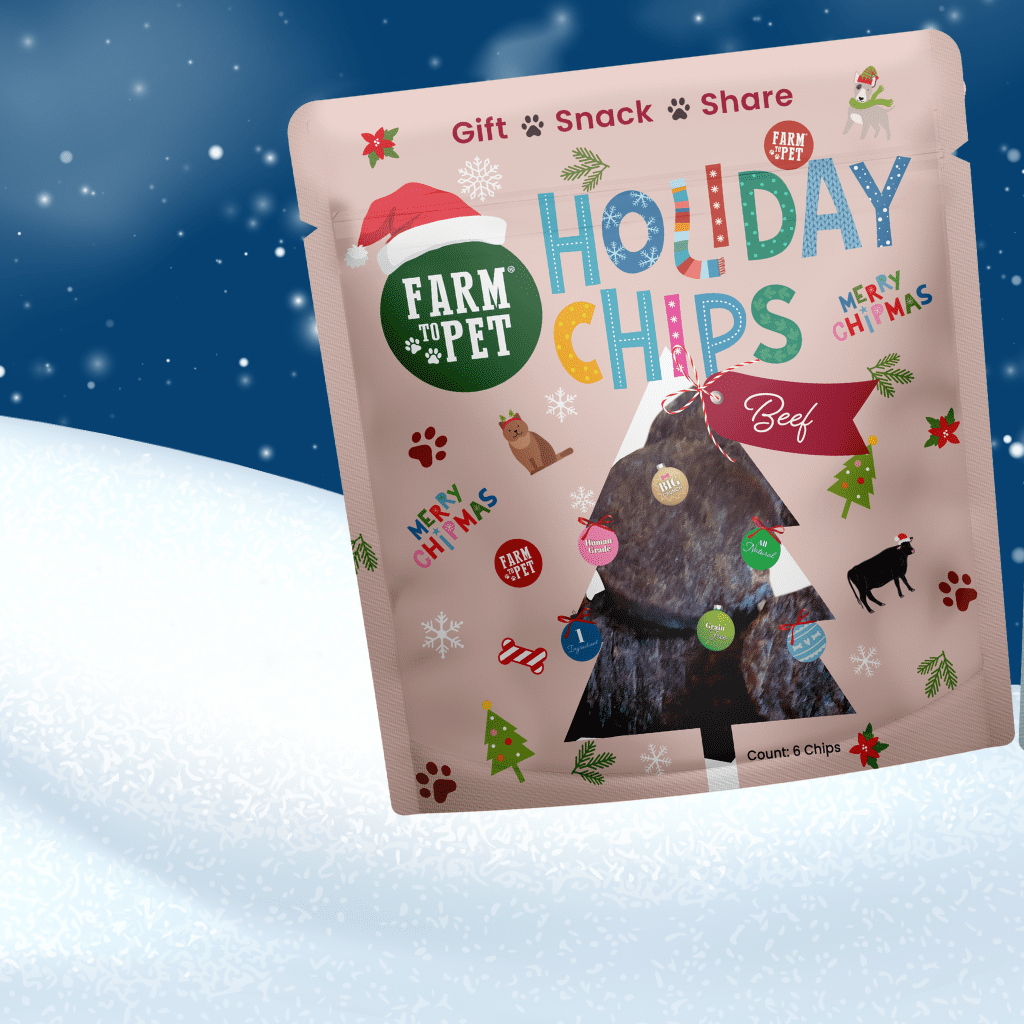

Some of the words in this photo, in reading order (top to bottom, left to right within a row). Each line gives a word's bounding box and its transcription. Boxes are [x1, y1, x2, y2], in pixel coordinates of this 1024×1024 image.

[452, 116, 508, 144] Gift
[555, 100, 653, 132] Snack
[701, 88, 793, 115] Share
[772, 130, 806, 147] FARM
[780, 146, 803, 161] PET
[537, 156, 911, 294] HOLIDAY
[838, 270, 900, 313] MERRY
[418, 322, 440, 342] TO
[440, 314, 511, 363] PET
[553, 284, 803, 390] CHIPS
[744, 392, 818, 443] Beef
[659, 476, 681, 492] BIG
[406, 483, 462, 541] MERRY
[585, 538, 612, 546] Human
[588, 545, 611, 553] Grade
[499, 546, 532, 570] FARM
[513, 559, 536, 579] PET
[575, 628, 585, 643] 1
[747, 747, 789, 761] Count:
[792, 744, 801, 756] 6
[804, 742, 841, 757] Chips
